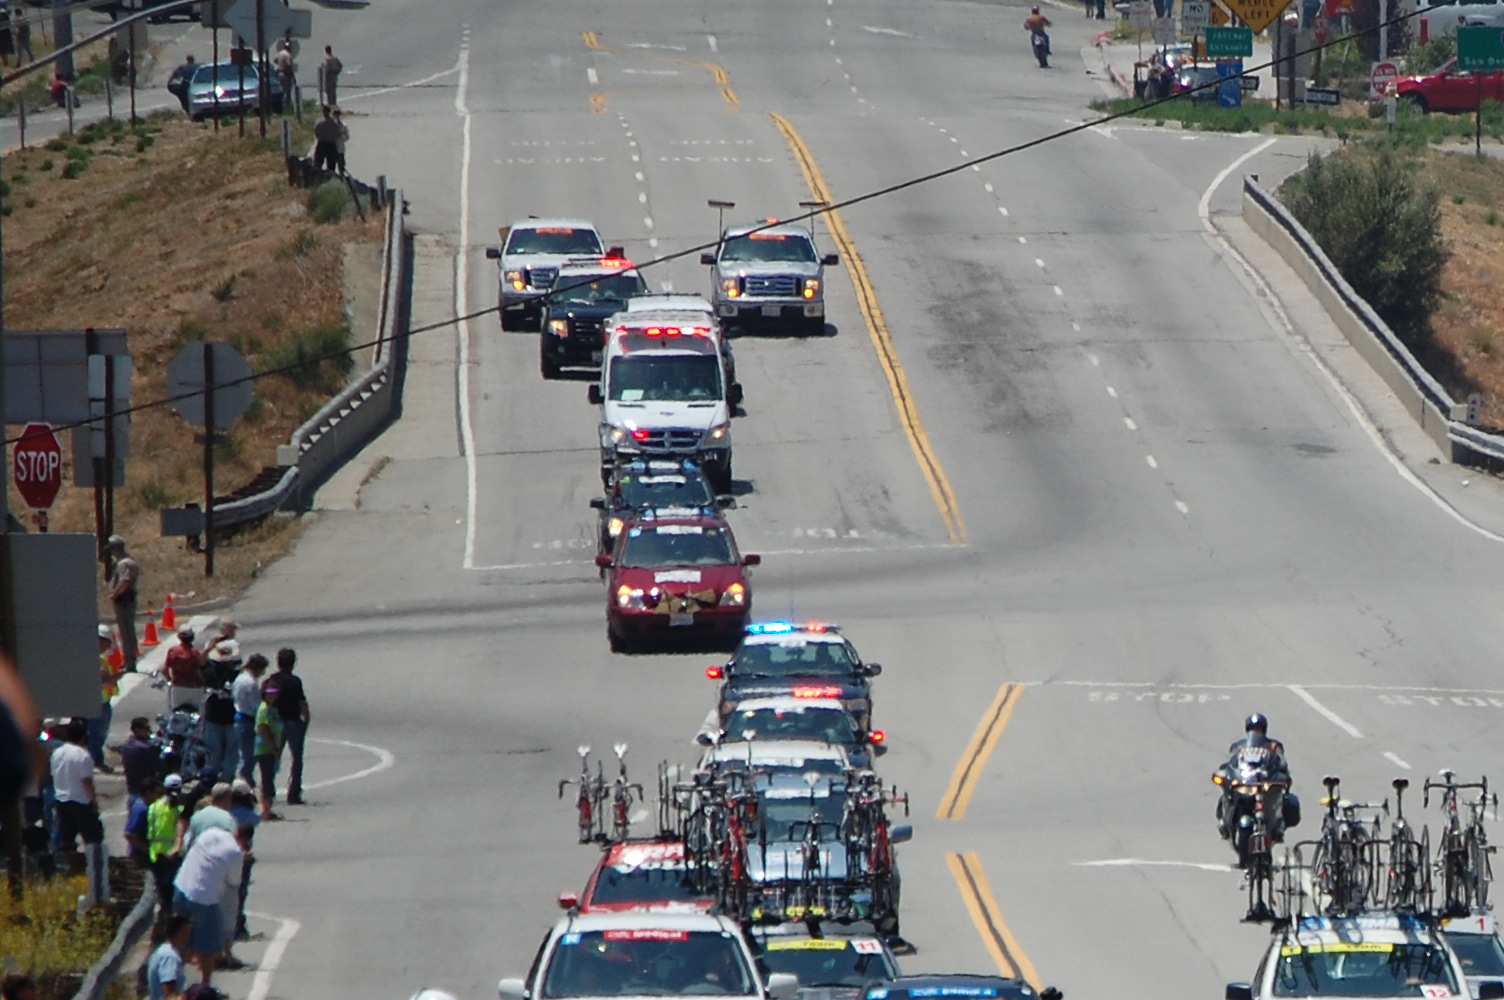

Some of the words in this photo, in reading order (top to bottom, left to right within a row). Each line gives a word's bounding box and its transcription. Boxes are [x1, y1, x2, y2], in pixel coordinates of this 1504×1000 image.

[1244, 11, 1271, 20] LEFT
[17, 451, 59, 482] STOP
[1087, 690, 1231, 705] STOP
[1476, 917, 1486, 932] 1
[856, 942, 878, 951] 11
